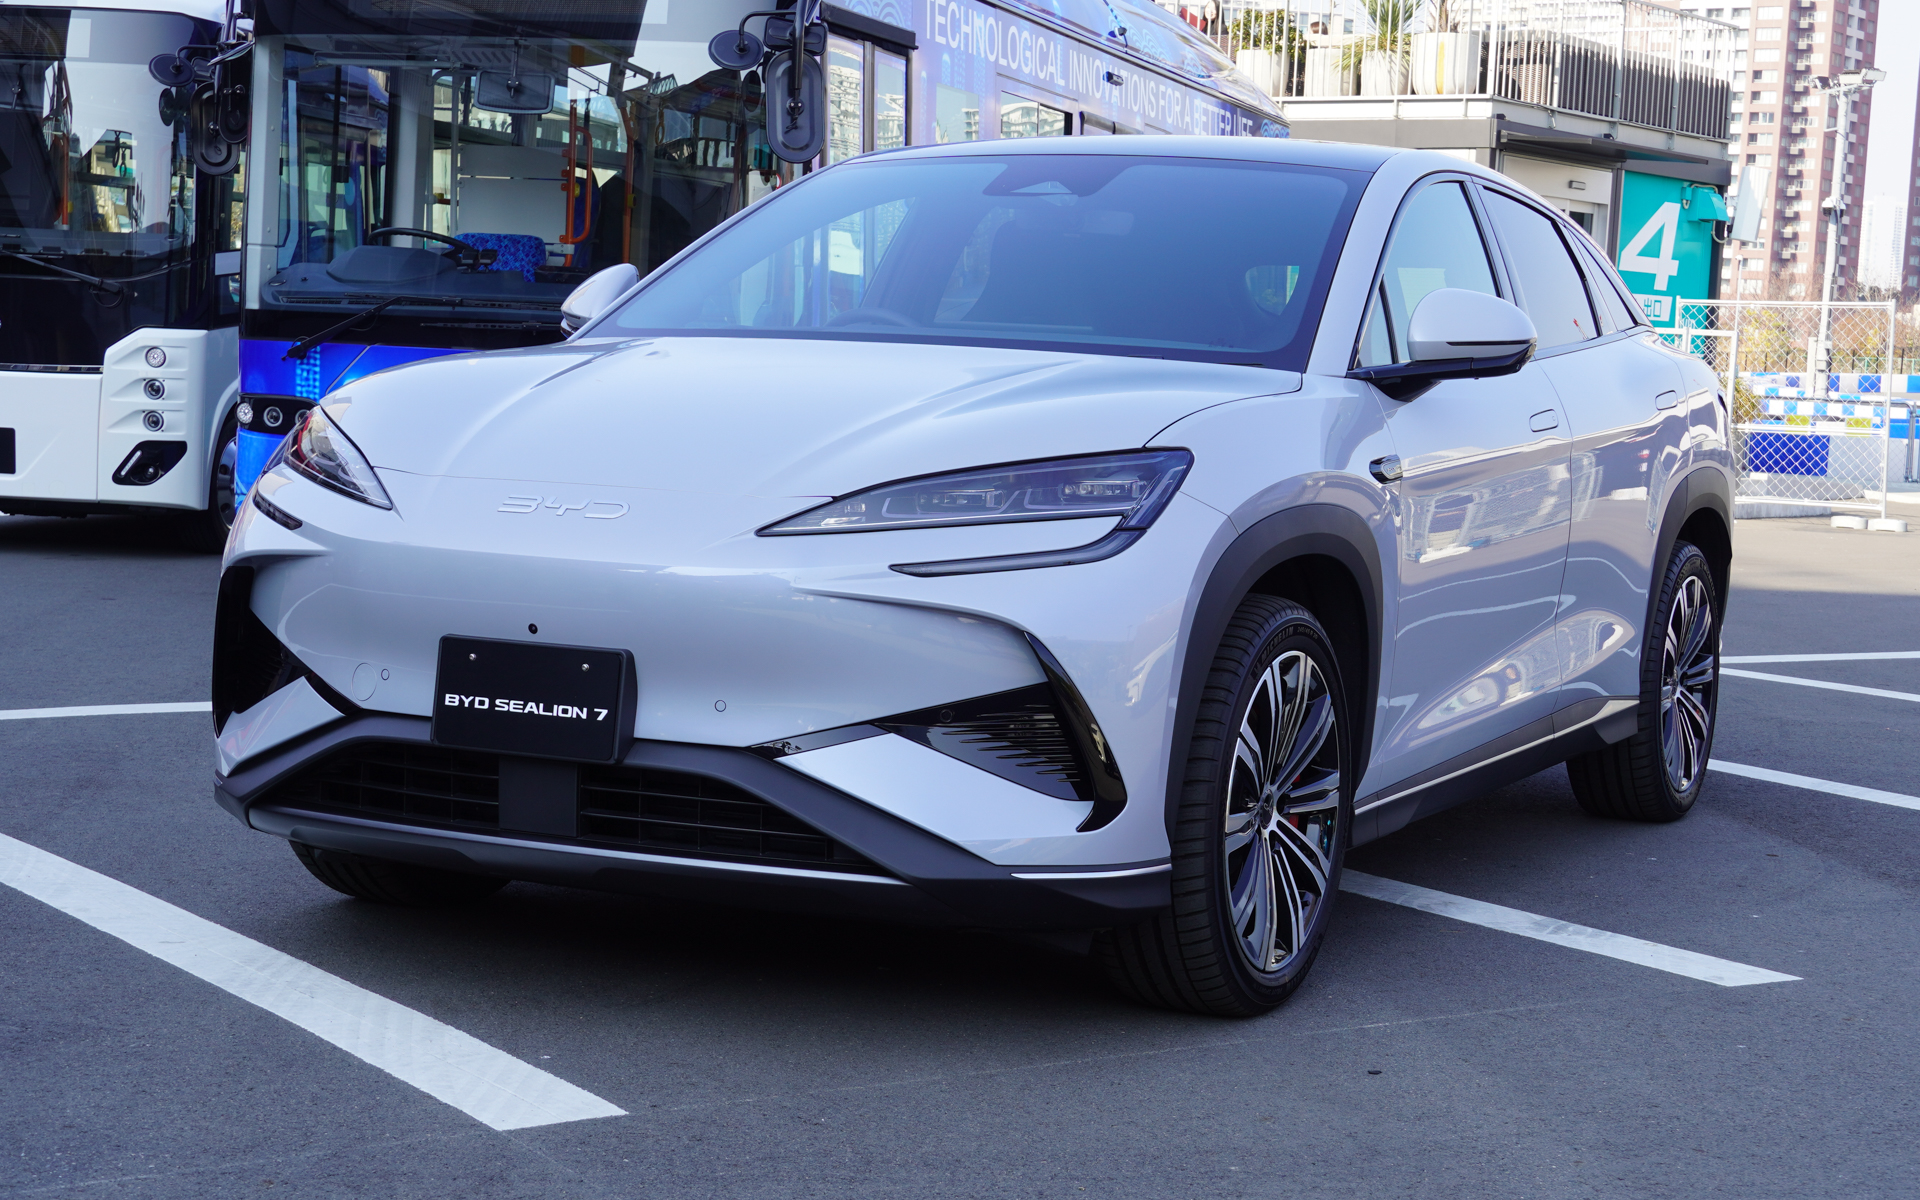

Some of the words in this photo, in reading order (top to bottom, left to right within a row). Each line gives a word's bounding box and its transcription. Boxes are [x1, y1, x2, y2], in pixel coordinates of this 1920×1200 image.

[925, 0, 1066, 87] TECHNOLOGICAL
[1069, 49, 1157, 119] INNOVATIONS
[1158, 84, 1182, 128] FOR
[1183, 95, 1192, 132] A
[1193, 99, 1232, 136] BETTER
[1618, 201, 1680, 291] 4
[1643, 297, 1662, 318] 出口
[497, 495, 631, 520] BYD
[444, 693, 490, 710] BYD
[494, 698, 588, 720] SEALION
[593, 708, 609, 721] 7
